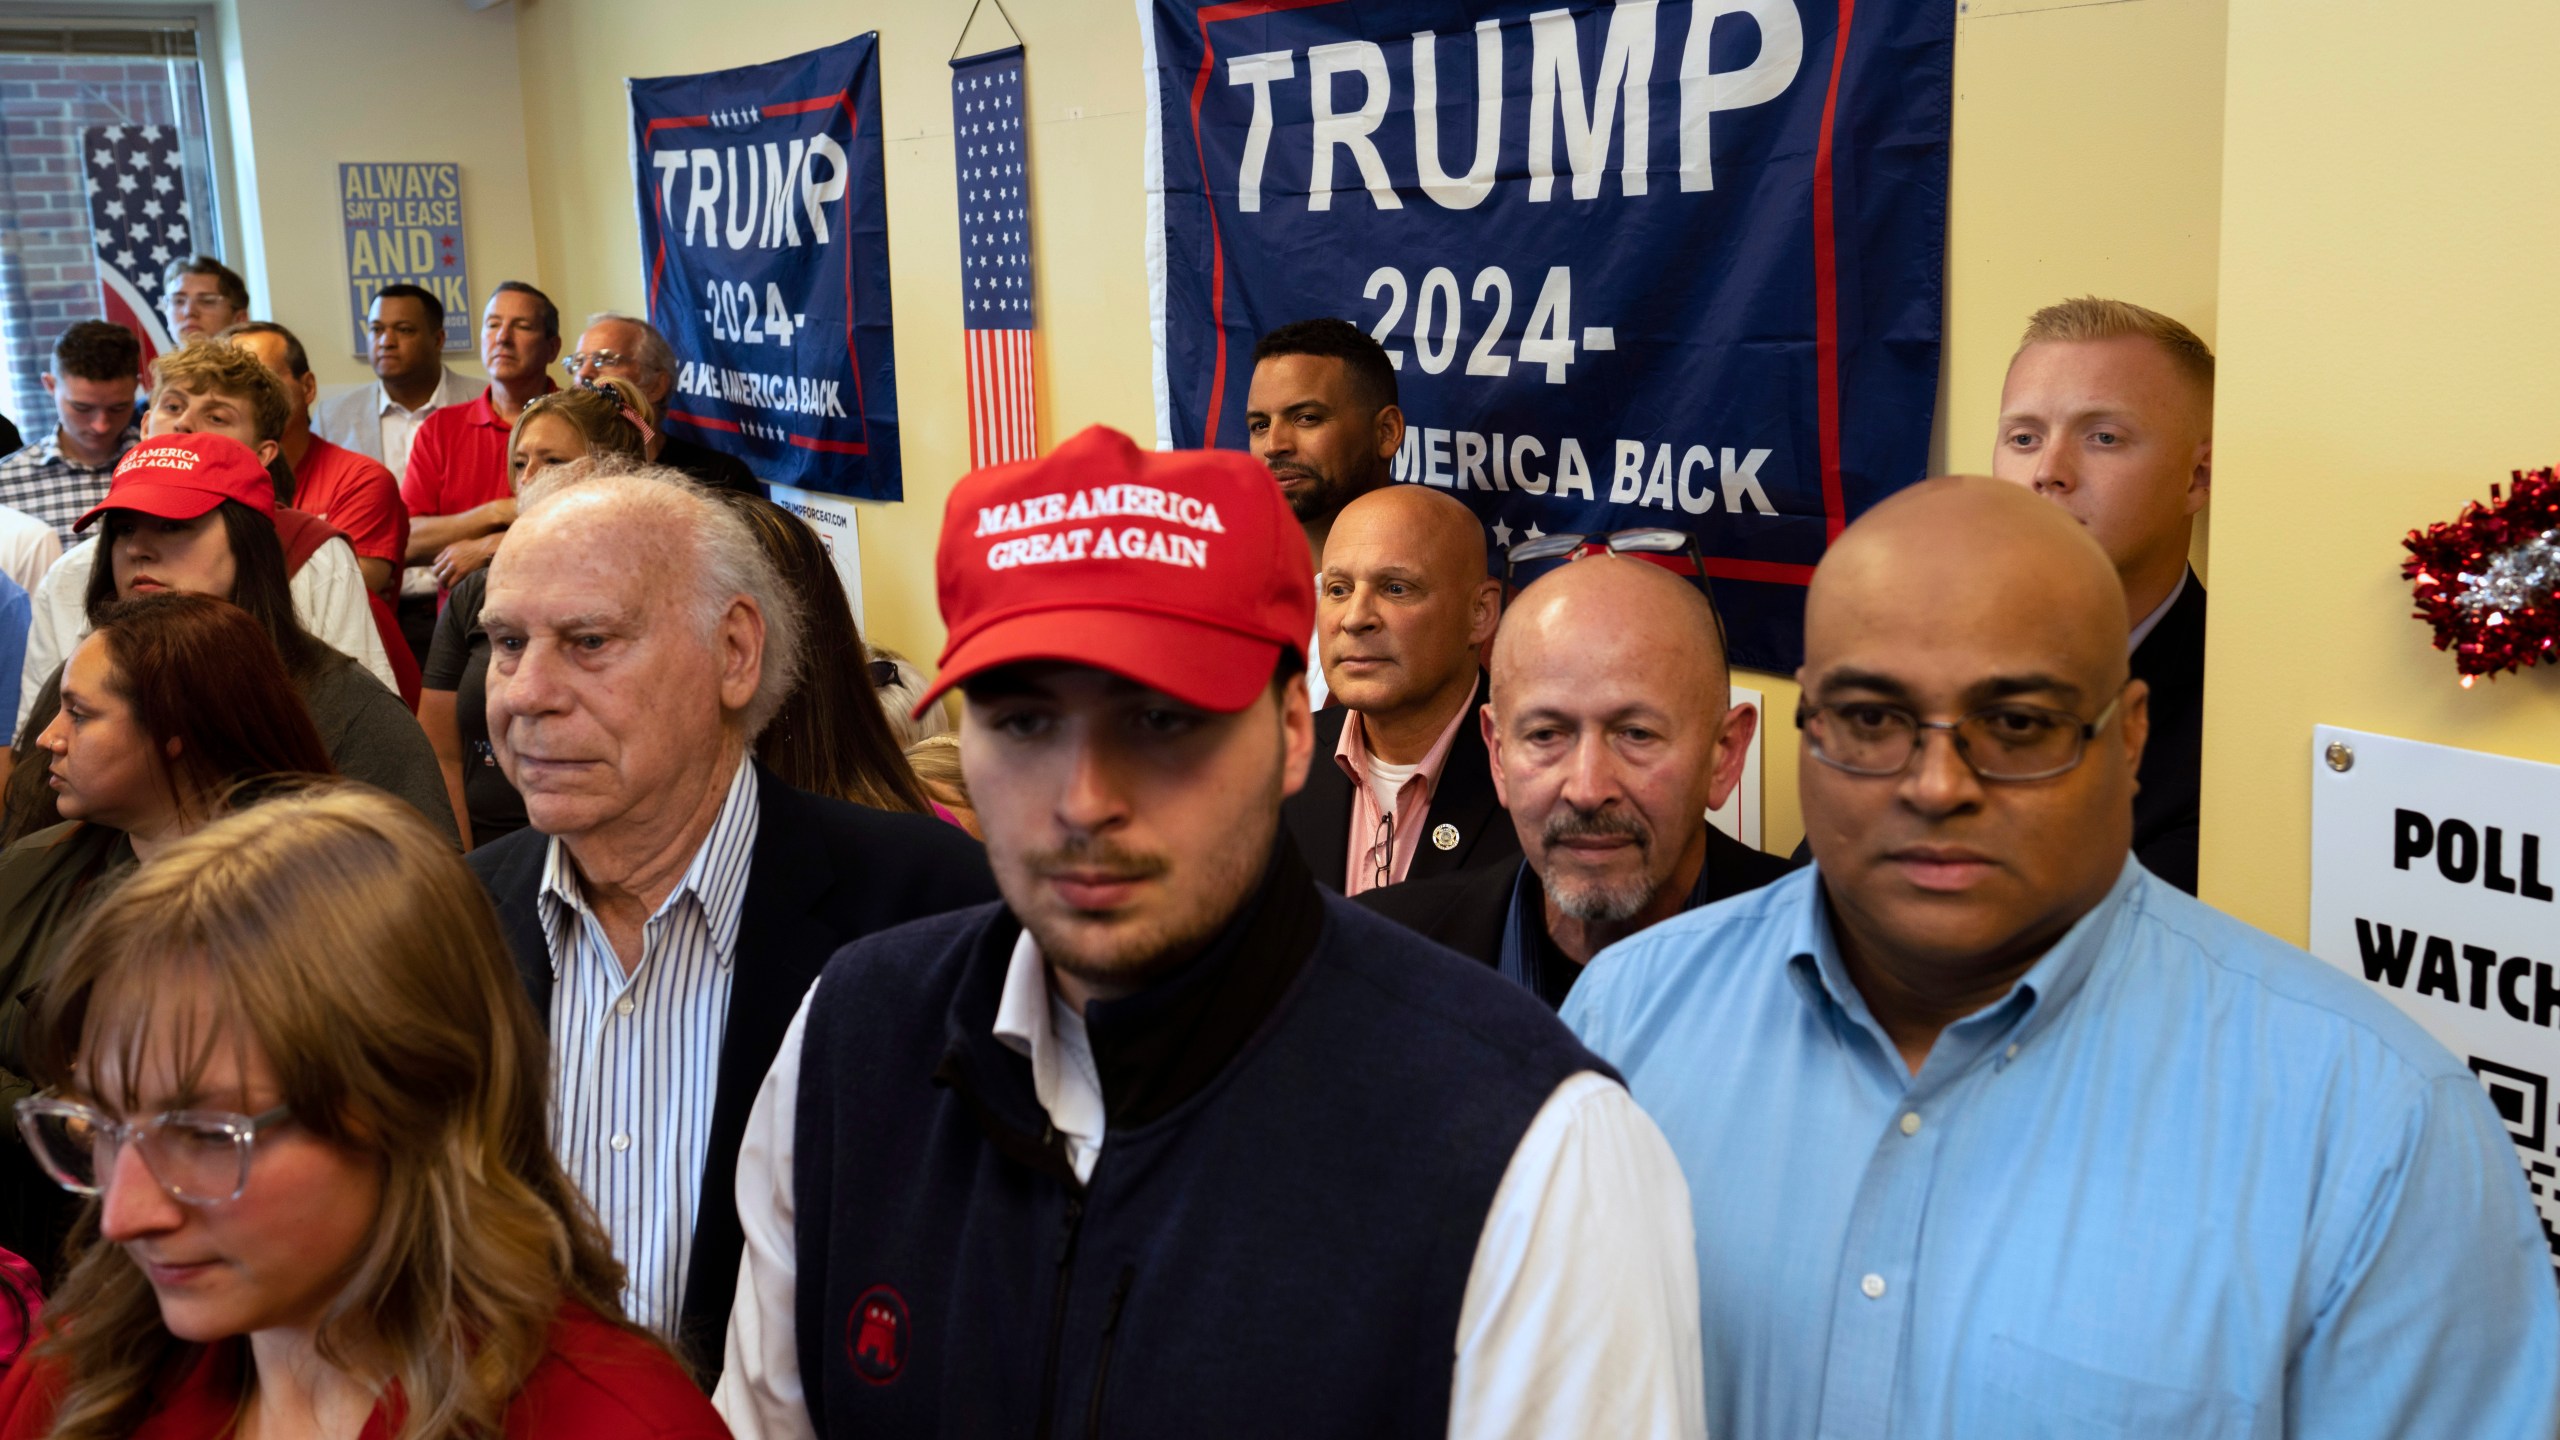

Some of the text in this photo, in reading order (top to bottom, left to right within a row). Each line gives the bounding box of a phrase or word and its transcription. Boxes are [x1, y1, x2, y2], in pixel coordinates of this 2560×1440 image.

[1227, 0, 1805, 213] TRUMP
[346, 165, 457, 200] ALWAYS
[653, 132, 848, 250] TRUMP
[346, 201, 458, 227] SAY PLEASE
[352, 229, 435, 276] AND
[704, 280, 805, 346] -2024-
[676, 360, 848, 418] AKE AMERICA BACK
[138, 447, 200, 462] AMERICA
[146, 458, 193, 470] AGAIN
[1390, 425, 1779, 517] MERICA BACK
[974, 484, 1226, 538] MAKE AMERICA
[987, 527, 1208, 571] GREAT AGAIN
[2394, 807, 2554, 903] POLL
